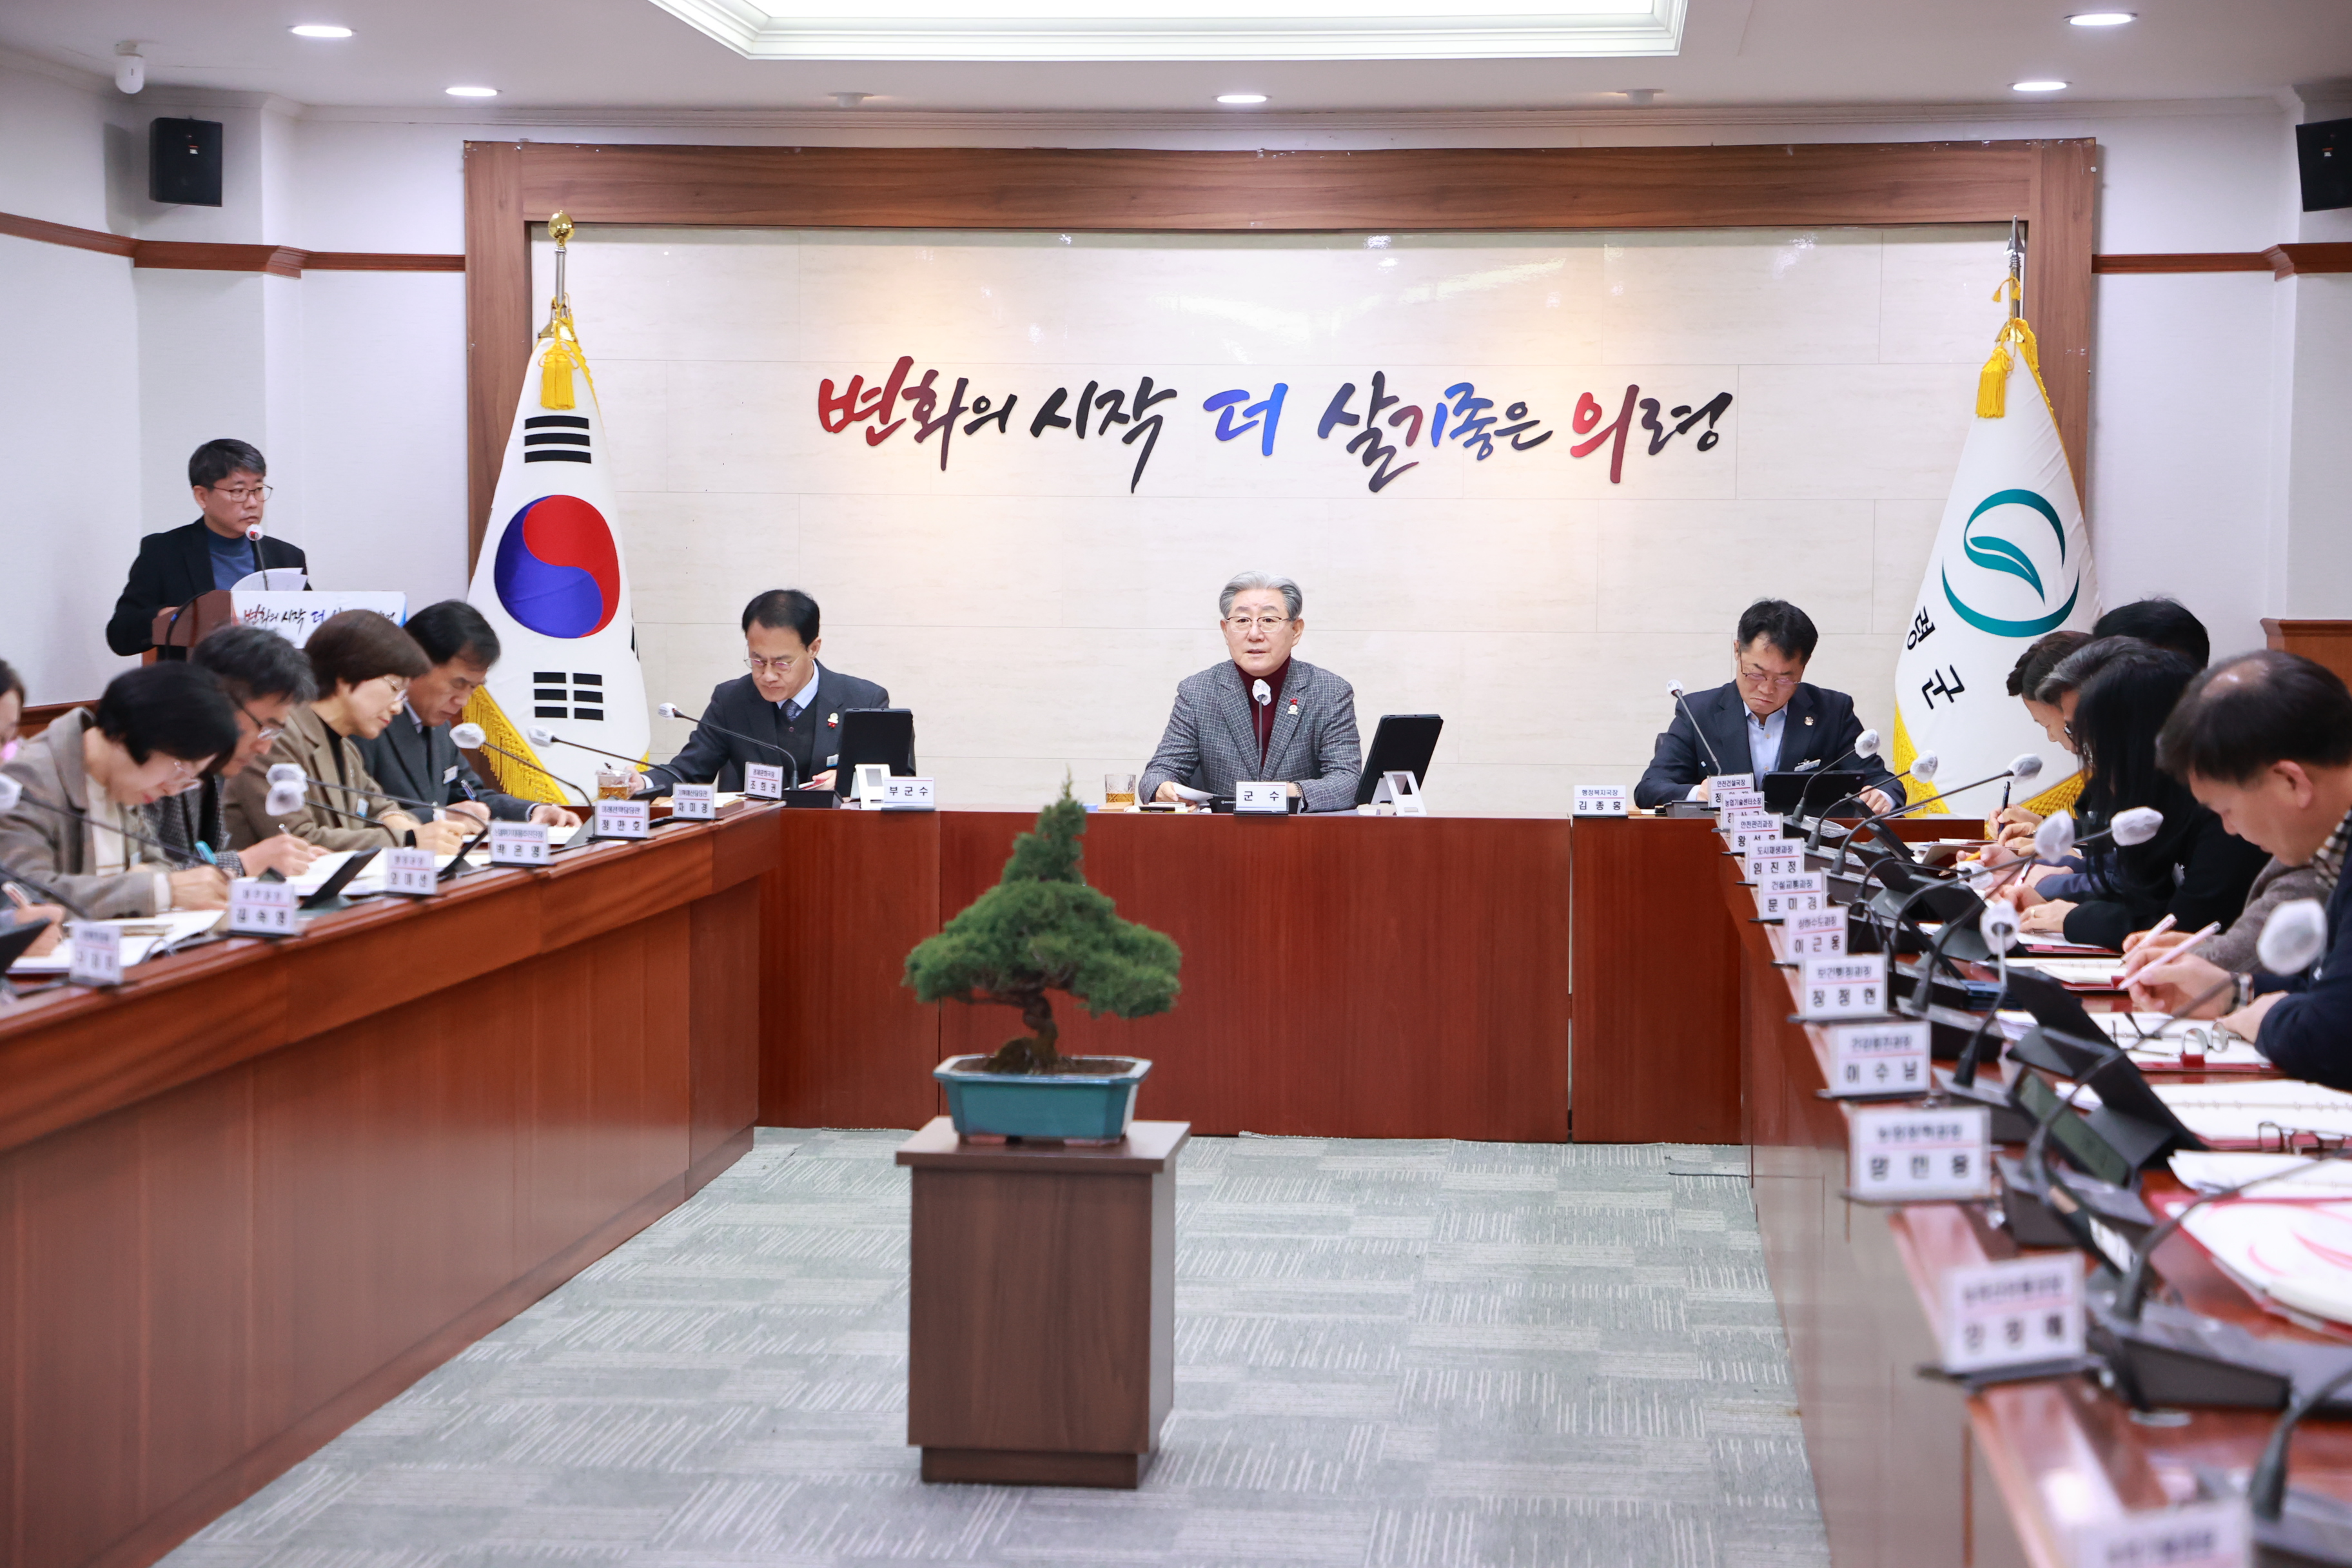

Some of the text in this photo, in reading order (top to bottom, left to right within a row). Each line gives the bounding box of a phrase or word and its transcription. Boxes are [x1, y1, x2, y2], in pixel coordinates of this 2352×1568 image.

[816, 355, 1734, 494] 변화의 시작 더 살기좋은 의령
[281, 608, 306, 636] 시작
[311, 609, 326, 623] 더
[1717, 779, 1745, 788] 안전건설국장
[678, 789, 707, 798] 기획예산담당관
[889, 786, 928, 796] 부군수
[1244, 790, 1279, 801] 군수
[678, 801, 707, 814] 차미경
[1578, 801, 1621, 810] 김종홍
[1725, 798, 1761, 807] 농업기술센터소장
[601, 805, 640, 814] 미래전략담당관
[1741, 820, 1773, 829] 안전관리과장
[1757, 845, 1793, 855] 도시재생과장
[1754, 861, 1796, 875] 임진정
[1772, 879, 1813, 891] 건설교통과장
[1798, 916, 1837, 930] 상하수도과장
